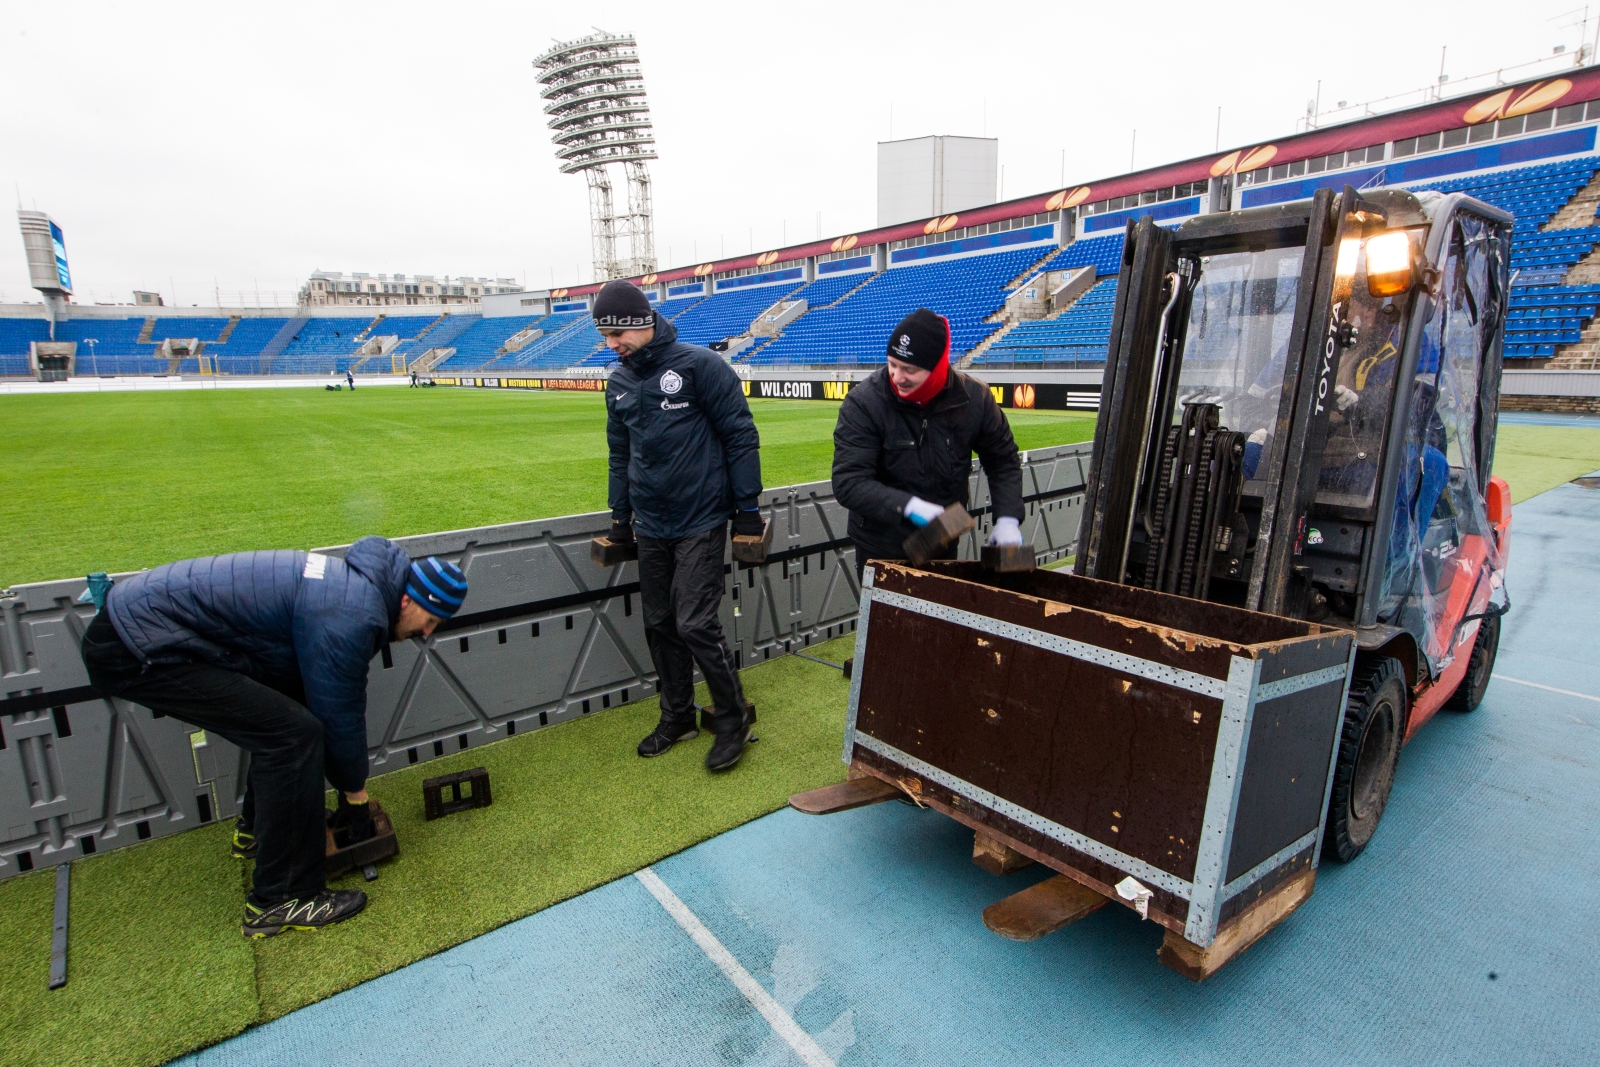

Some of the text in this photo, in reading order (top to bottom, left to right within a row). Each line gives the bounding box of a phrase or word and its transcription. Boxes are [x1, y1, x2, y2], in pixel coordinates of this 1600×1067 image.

[593, 315, 653, 326] adidas
[1314, 301, 1342, 415] TOYOTA
[547, 380, 558, 388] UEFA
[559, 380, 577, 389] EUROPA
[577, 380, 595, 389] LEAGUE
[760, 382, 812, 398] wu.com
